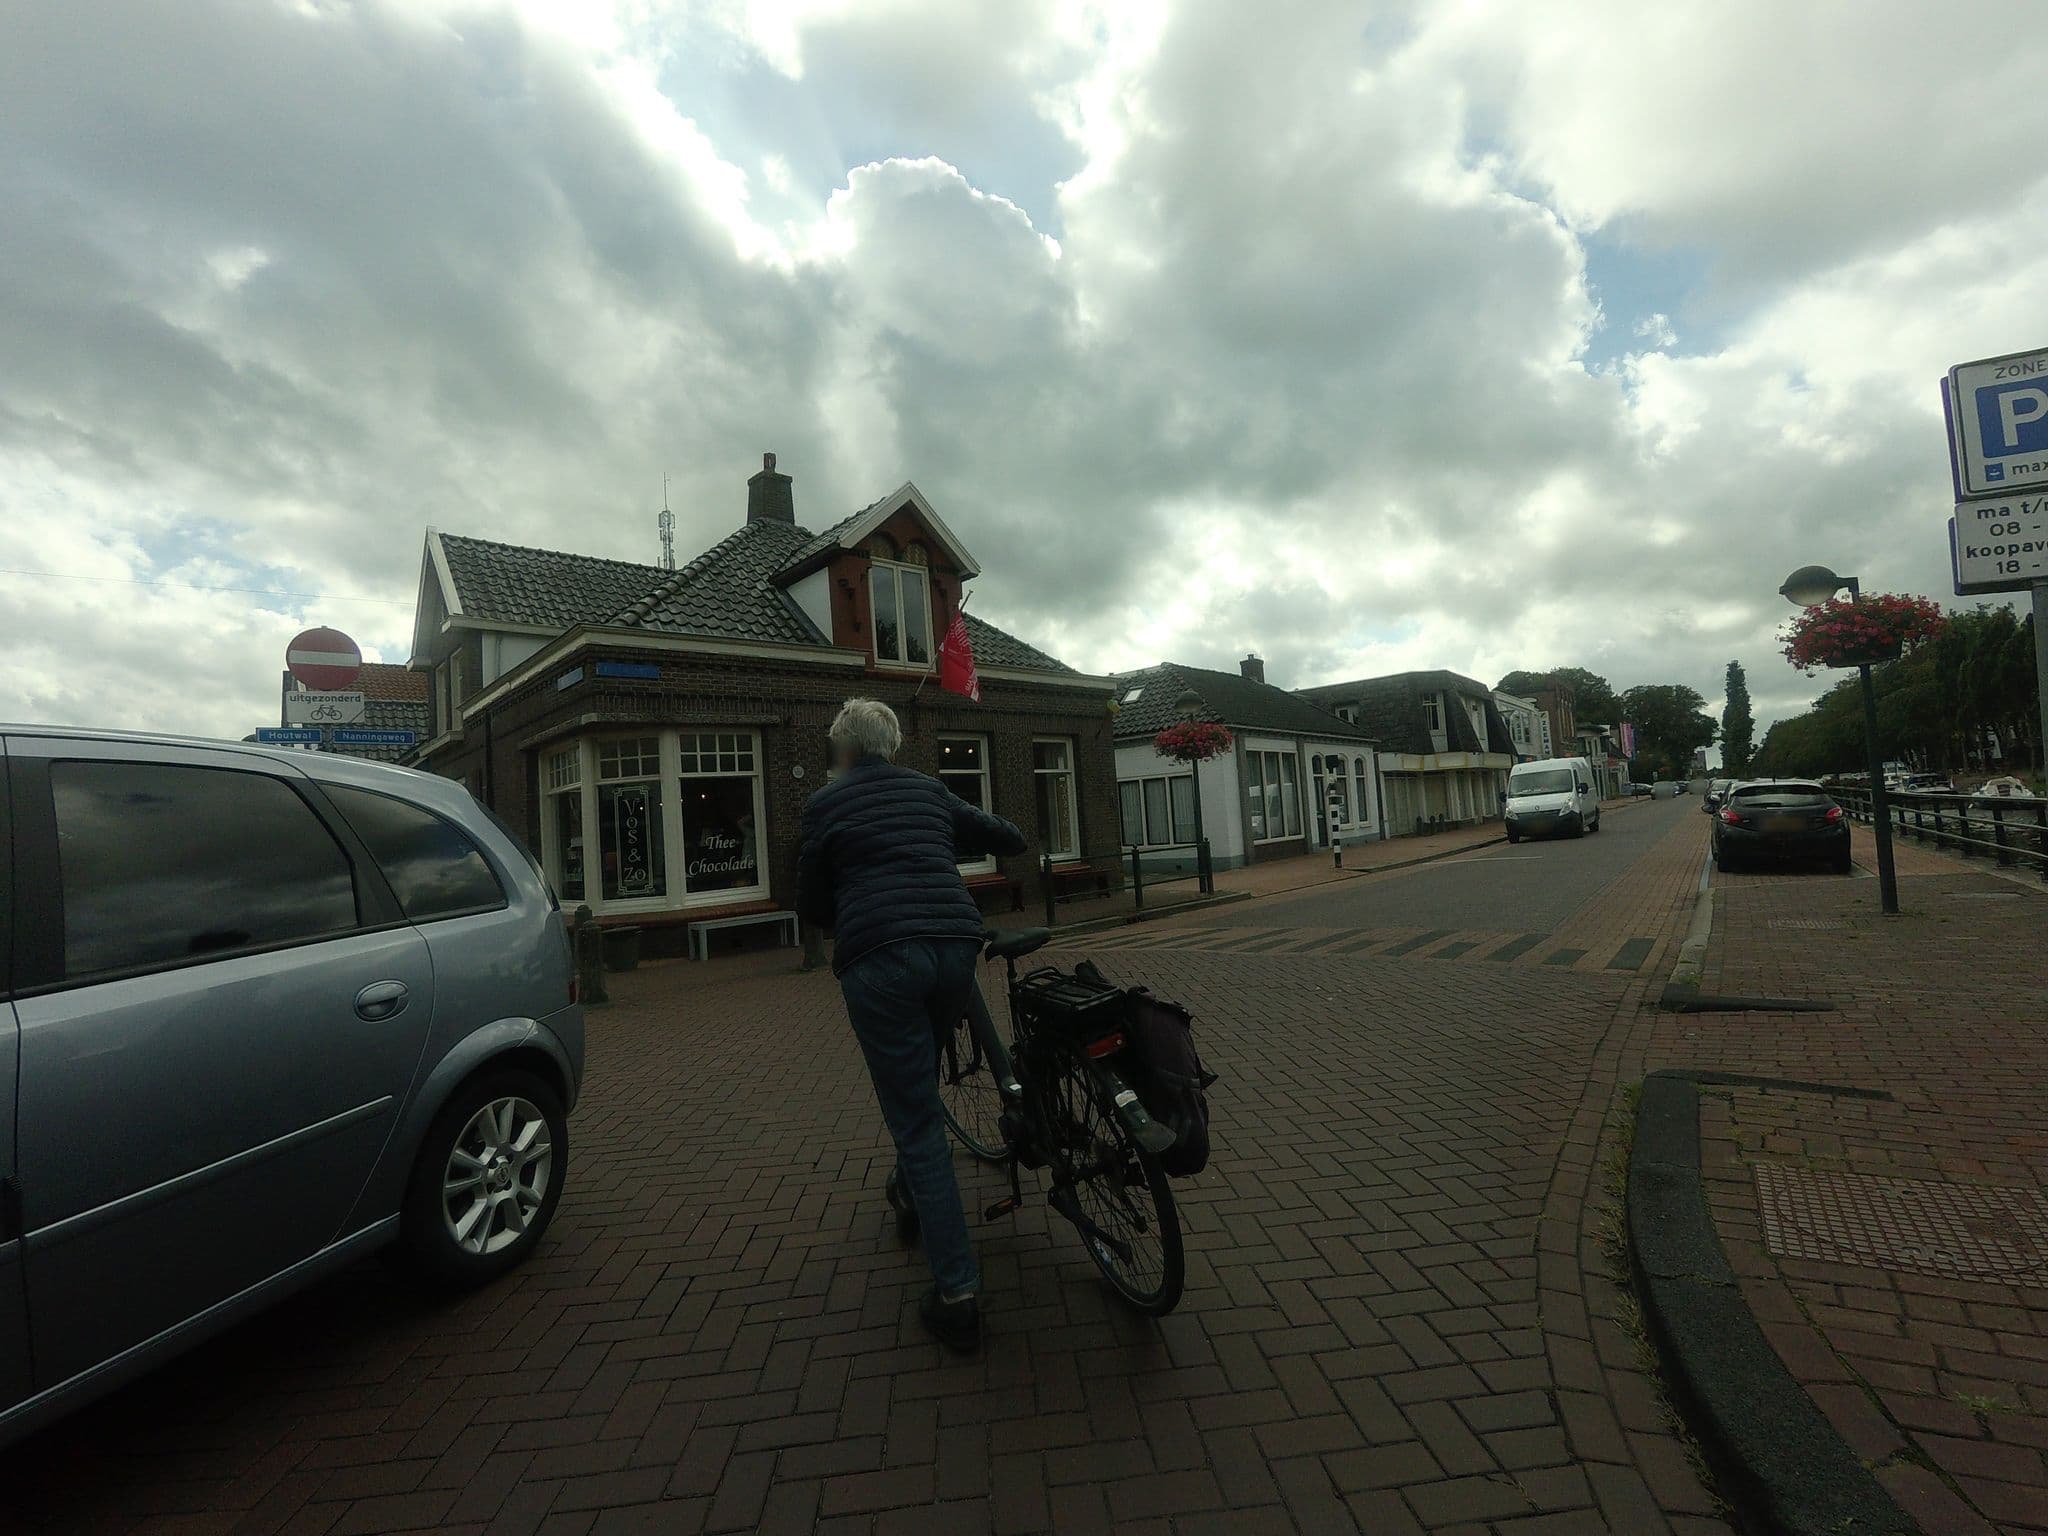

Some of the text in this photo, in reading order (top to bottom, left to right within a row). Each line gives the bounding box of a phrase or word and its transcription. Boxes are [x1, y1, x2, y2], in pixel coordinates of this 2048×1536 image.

[1994, 360, 2047, 379] ZONE
[1998, 388, 2048, 447] P
[1977, 506, 2010, 519] ma
[1990, 521, 2021, 537] 08
[1967, 541, 2048, 558] koopav
[1996, 560, 2020, 574] 18
[290, 694, 361, 704] uitgezonderd
[269, 731, 312, 740] Houtwal
[1542, 720, 1551, 755] ZEEMAN
[705, 833, 736, 850] Thee
[688, 854, 754, 878] Chocolade
